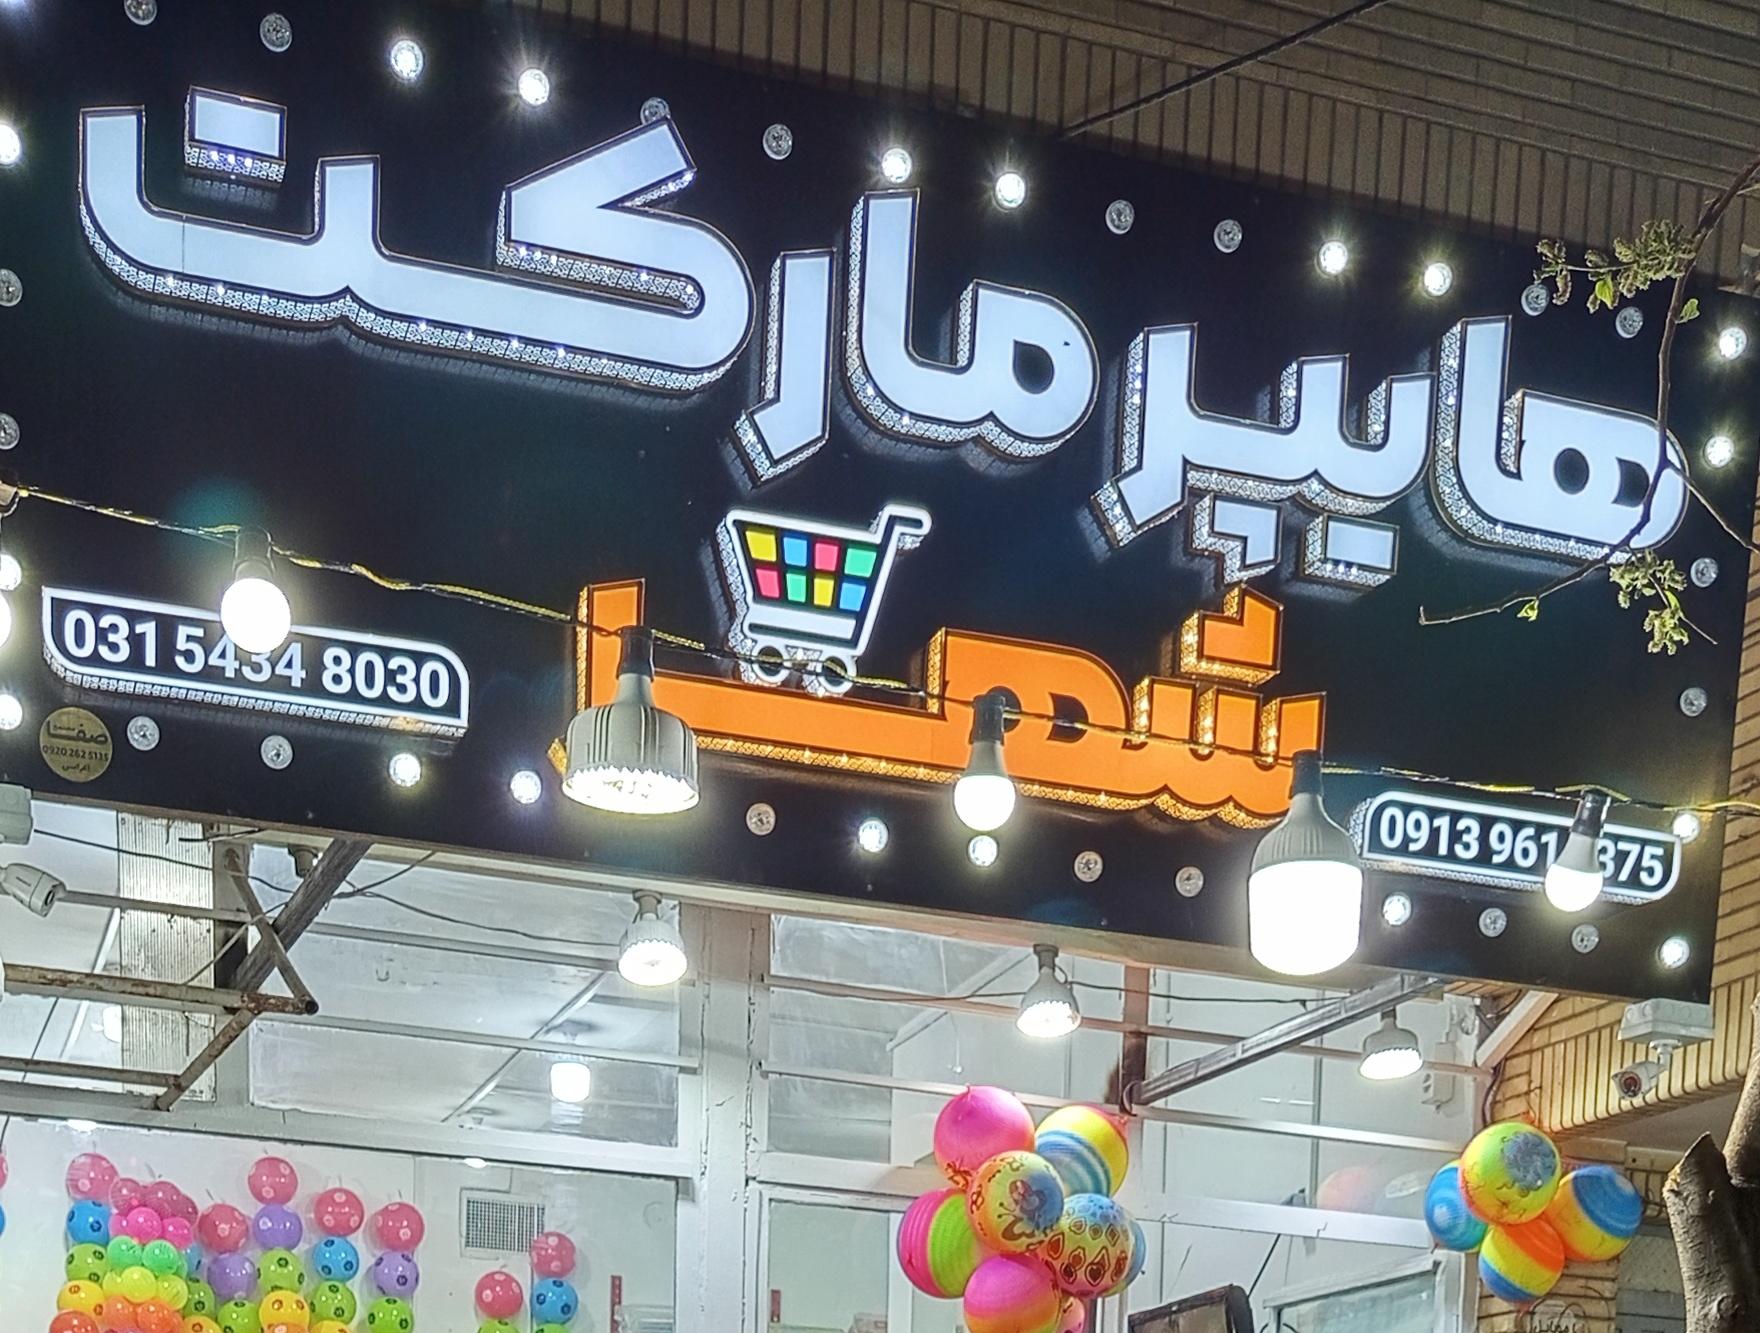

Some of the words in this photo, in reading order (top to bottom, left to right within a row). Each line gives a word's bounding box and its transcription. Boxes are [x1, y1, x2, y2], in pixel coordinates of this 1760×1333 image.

[79, 84, 1100, 484] مارکت
[1094, 314, 1690, 588] هایپر
[63, 608, 159, 668] 031
[174, 624, 307, 689] 5434
[321, 646, 450, 708] 8030
[1379, 806, 1481, 860] 0913
[1488, 822, 1559, 869] 961
